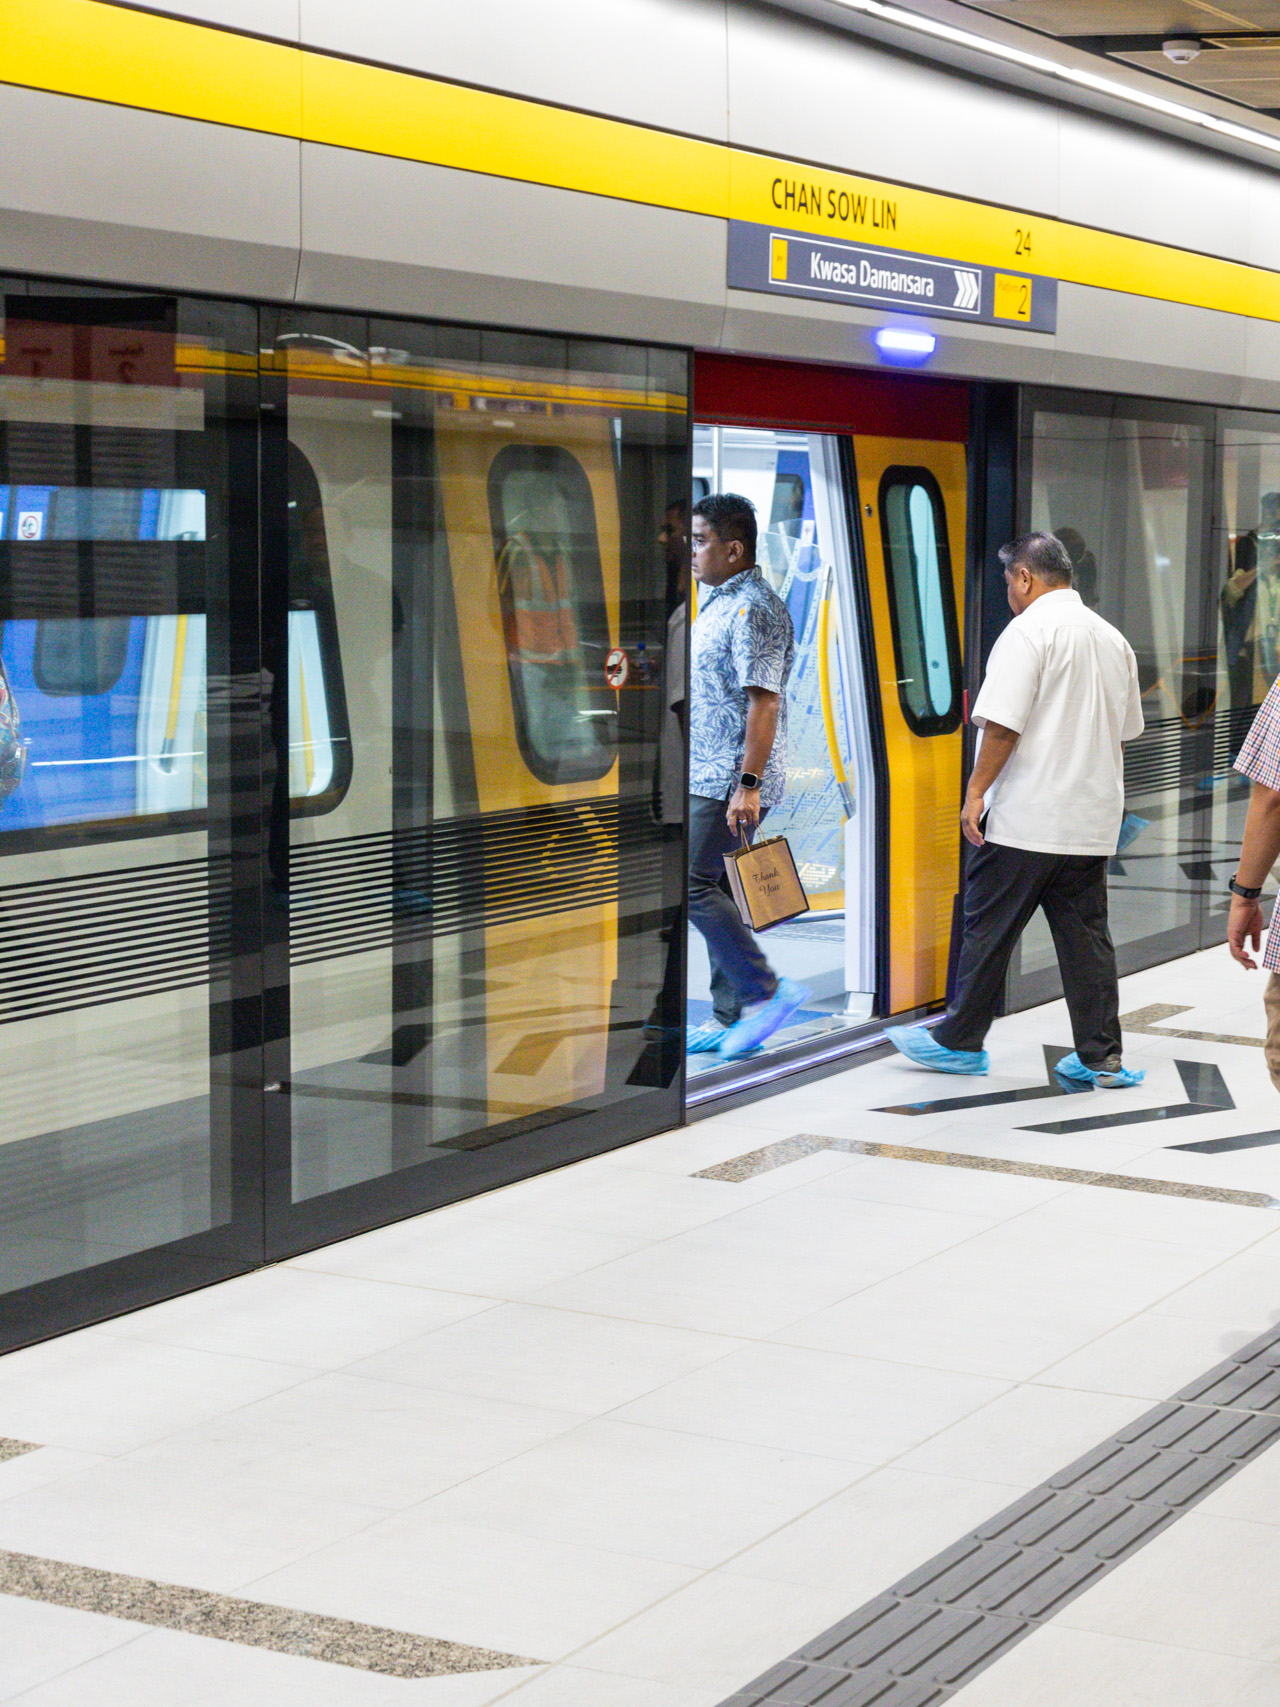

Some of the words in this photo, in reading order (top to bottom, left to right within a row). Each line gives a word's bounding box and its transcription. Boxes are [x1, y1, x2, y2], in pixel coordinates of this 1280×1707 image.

[771, 177, 821, 216] CHAN
[827, 188, 867, 226] SOW
[872, 197, 897, 231] LIN
[1014, 228, 1032, 257] 24
[810, 251, 856, 285] Kwasa
[859, 260, 934, 297] Damansara
[1017, 284, 1028, 315] 2
[752, 867, 779, 883] Thank
[759, 883, 780, 897] You
